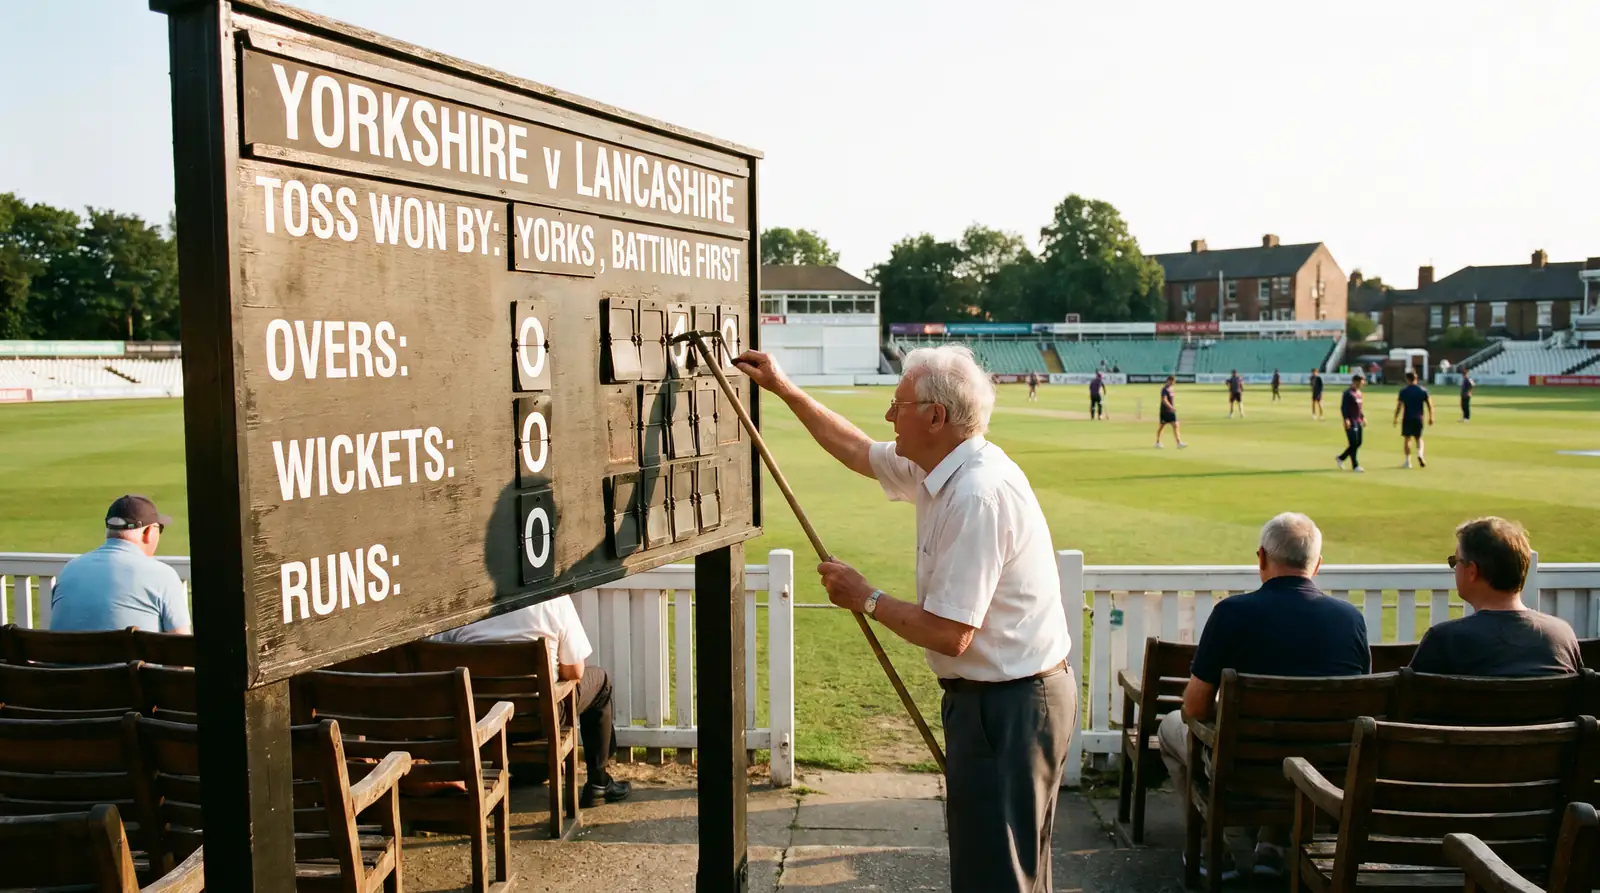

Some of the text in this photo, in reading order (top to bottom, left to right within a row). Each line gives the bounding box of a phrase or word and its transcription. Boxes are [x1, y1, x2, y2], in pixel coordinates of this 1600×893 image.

[271, 63, 735, 224] YORKSHIRE v LANCASHIRE
[255, 175, 359, 242] TOSS
[368, 192, 447, 251] WON
[456, 206, 500, 256] BY:
[612, 234, 691, 277] BATTING
[695, 242, 741, 282] FIRST
[265, 316, 546, 381] OVERS: 0
[272, 411, 548, 501] WICKETS: 0
[281, 507, 550, 624] RUNS: 0
